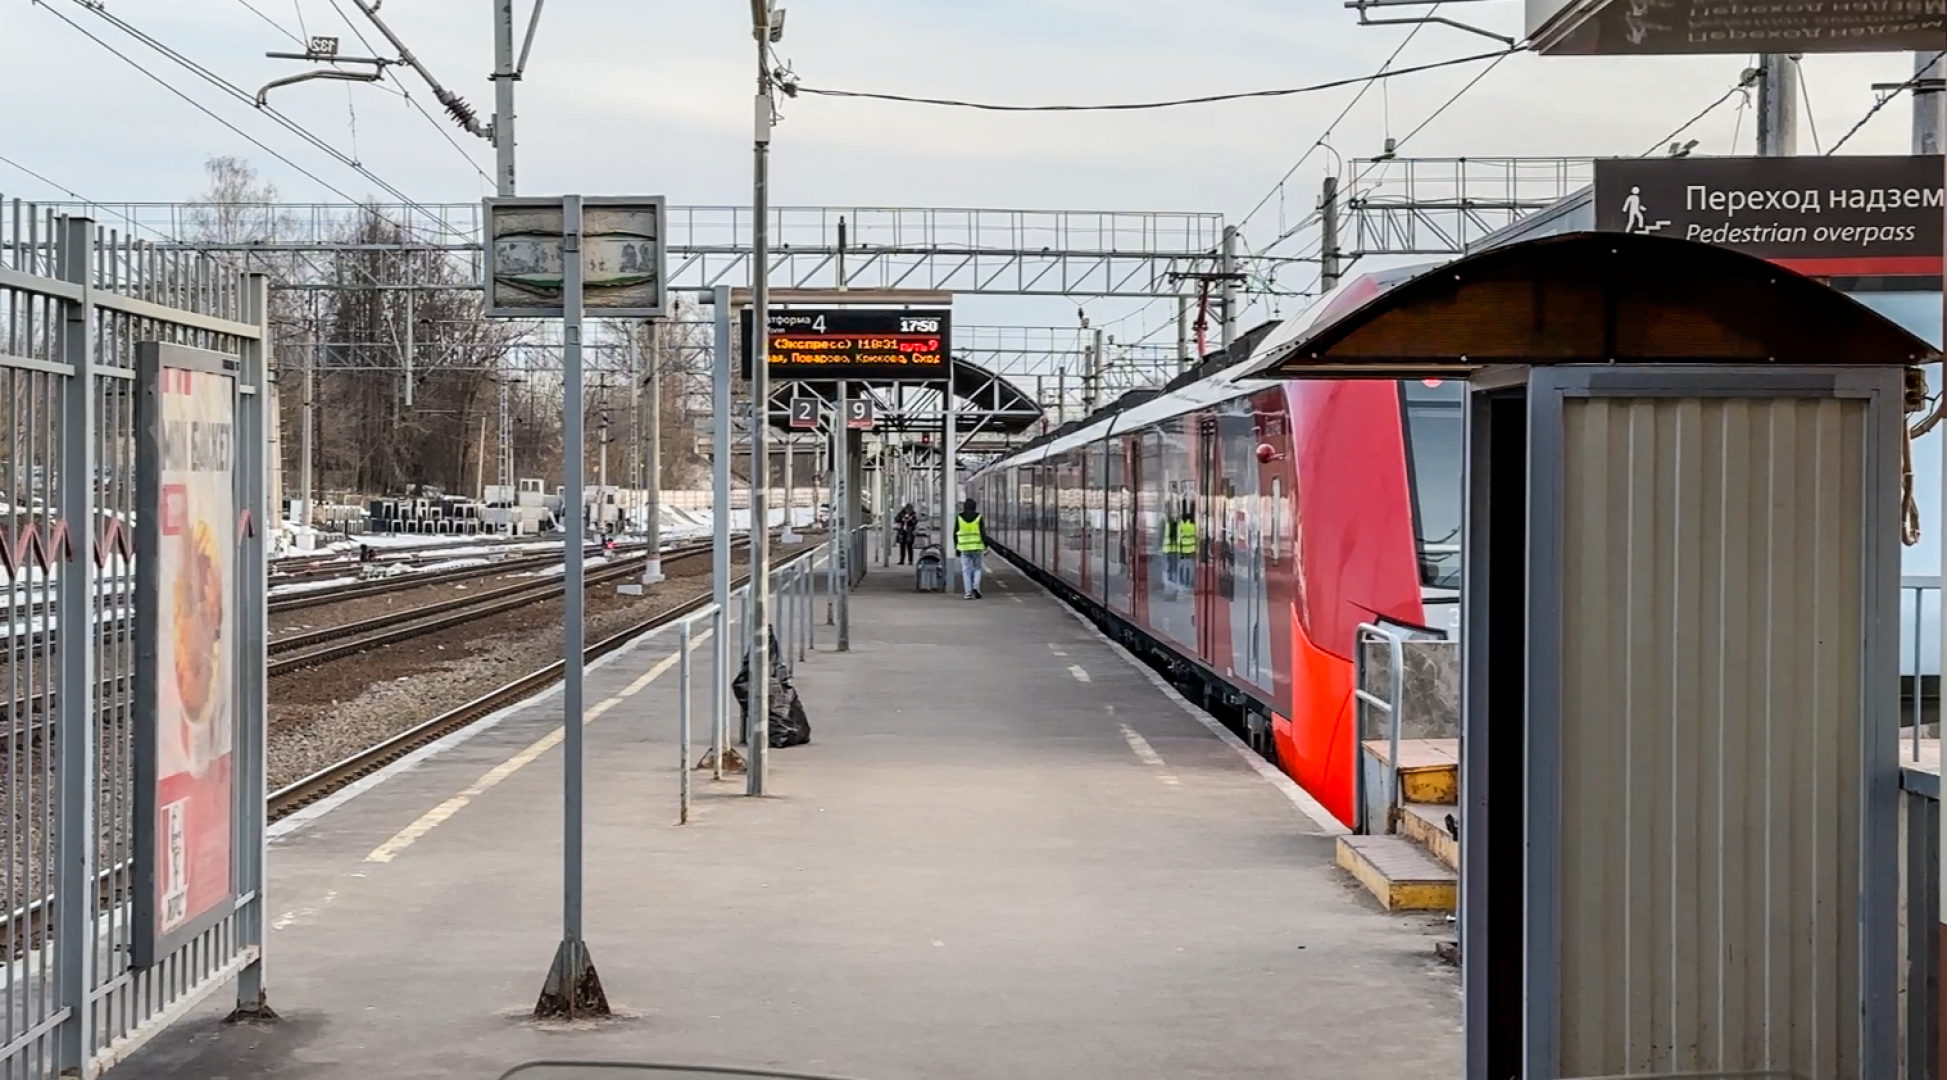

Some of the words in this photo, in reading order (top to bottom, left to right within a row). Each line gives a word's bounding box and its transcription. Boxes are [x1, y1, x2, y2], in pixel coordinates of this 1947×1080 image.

[1686, 185, 1820, 216] Переход
[1830, 186, 1945, 213] надзем
[1686, 222, 1807, 244] Pedestrian
[1814, 223, 1916, 246] overpass
[812, 314, 827, 334] 4
[899, 320, 939, 332] 17:50
[798, 402, 812, 420] 2
[852, 402, 866, 420] 9
